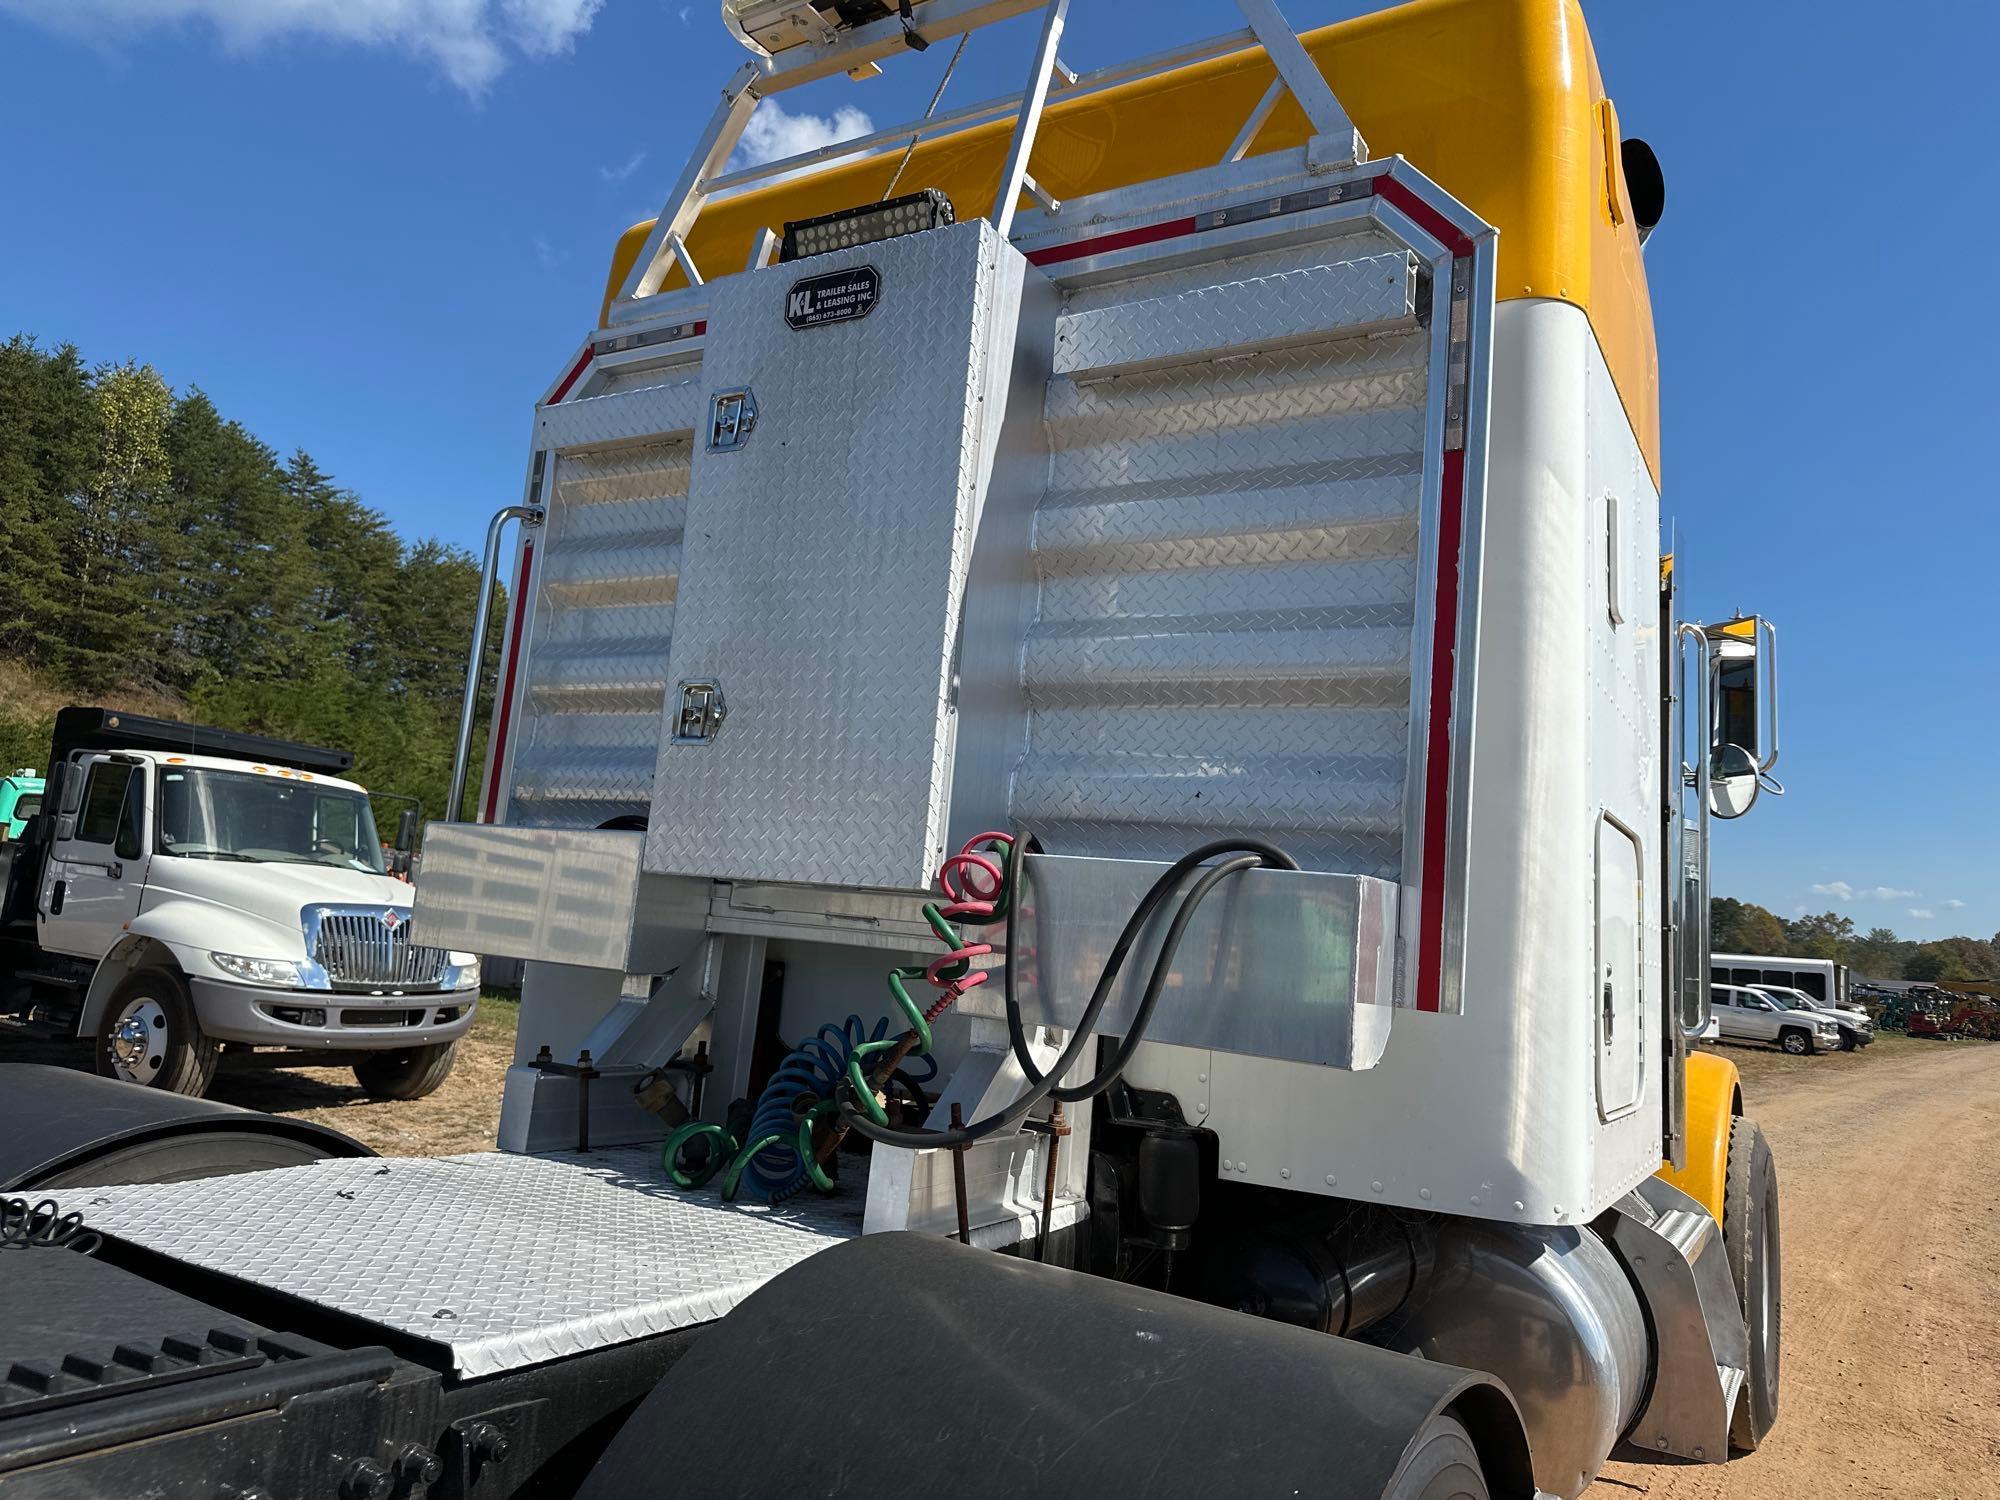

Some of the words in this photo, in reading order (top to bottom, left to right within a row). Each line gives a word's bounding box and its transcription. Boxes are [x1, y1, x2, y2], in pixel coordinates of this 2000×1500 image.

[817, 285, 846, 299] TRAILER
[847, 281, 870, 293] SALES
[816, 302, 821, 310] &
[823, 294, 855, 308] LEASING
[806, 314, 822, 324] (865)
